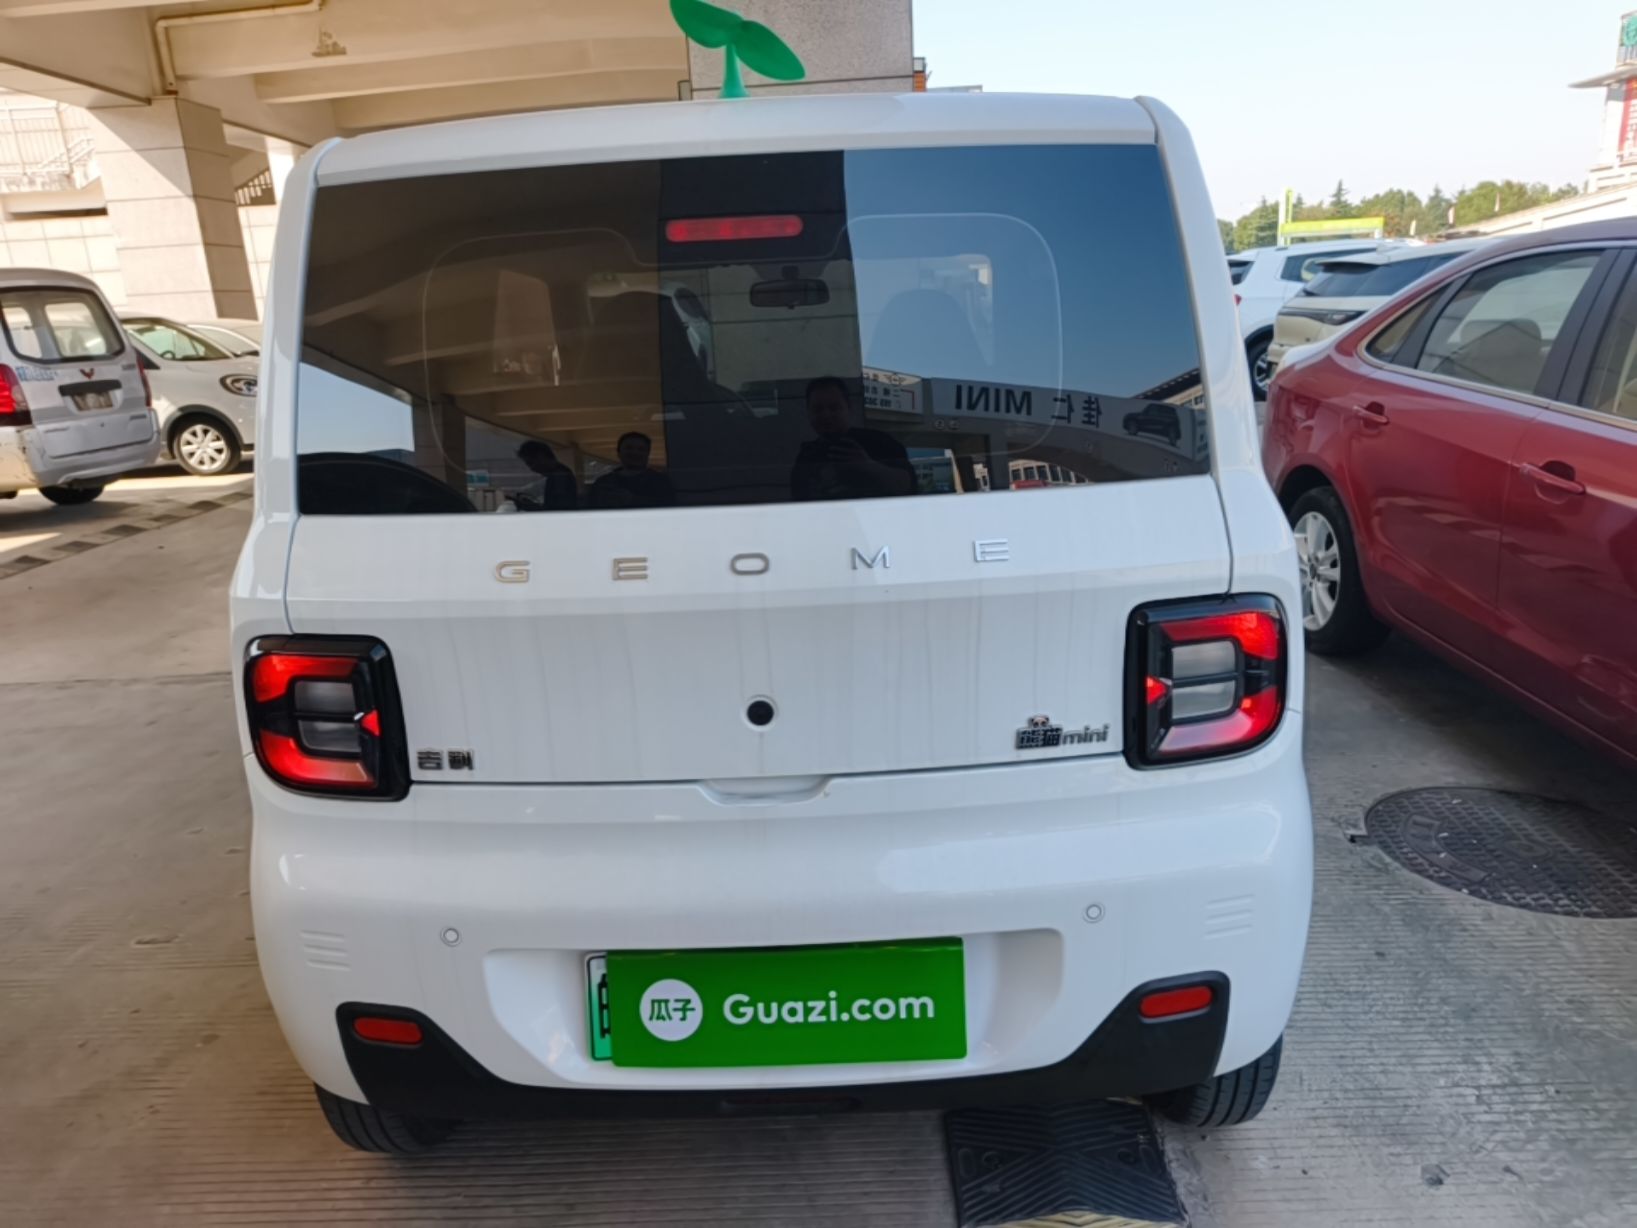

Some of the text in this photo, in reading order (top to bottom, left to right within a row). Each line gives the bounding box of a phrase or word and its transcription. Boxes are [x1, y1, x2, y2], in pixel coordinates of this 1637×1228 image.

[494, 538, 1010, 584] GEOME
[648, 998, 697, 1023] 瓜子
[723, 990, 935, 1026] Guazi.com
